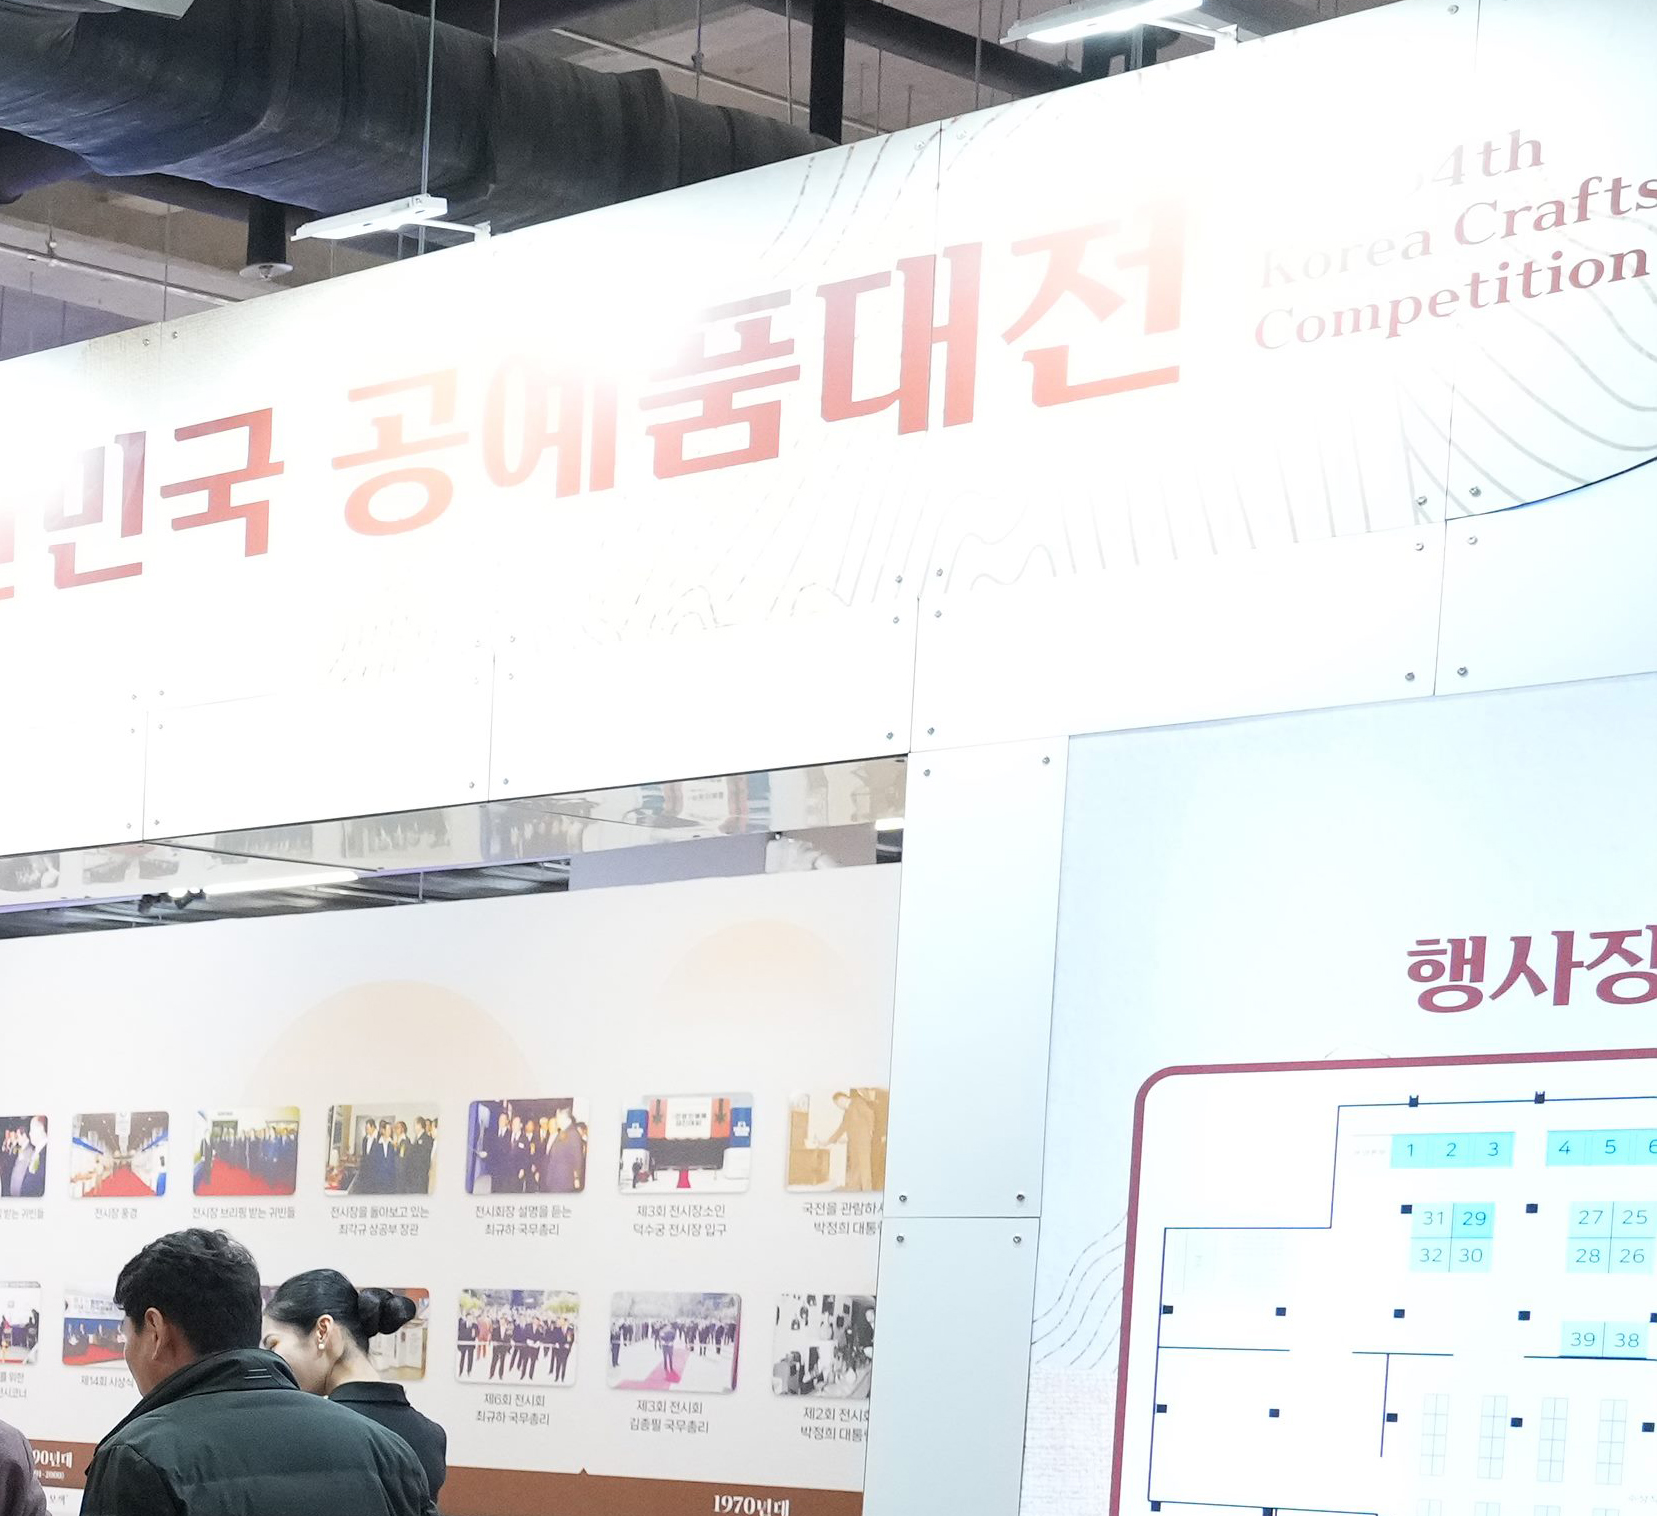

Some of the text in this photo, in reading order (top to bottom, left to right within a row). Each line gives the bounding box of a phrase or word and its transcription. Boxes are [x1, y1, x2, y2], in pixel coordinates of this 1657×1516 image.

[1407, 128, 1545, 196] 4th
[1454, 175, 1657, 246] Crafts
[1253, 245, 1651, 351] Competition
[331, 198, 1185, 538] 공예품대전
[1406, 924, 1657, 1014] 행사장
[1406, 1143, 1414, 1157] 1
[1446, 1142, 1457, 1157] 2
[1487, 1142, 1499, 1157] 3
[1558, 1140, 1571, 1155] 4
[1604, 1139, 1616, 1154] 5
[1422, 1210, 1444, 1225] 31
[1462, 1211, 1486, 1226] 29
[1578, 1210, 1604, 1225] 27
[1622, 1209, 1648, 1225] 25
[1419, 1248, 1442, 1263] 32
[1458, 1248, 1483, 1263] 30
[1575, 1248, 1600, 1263] 28
[1619, 1248, 1644, 1263] 26
[1570, 1332, 1595, 1347] 39
[1614, 1333, 1640, 1348] 38
[838, 1427, 868, 1442] 대통
[33, 1449, 73, 1469] 90년대
